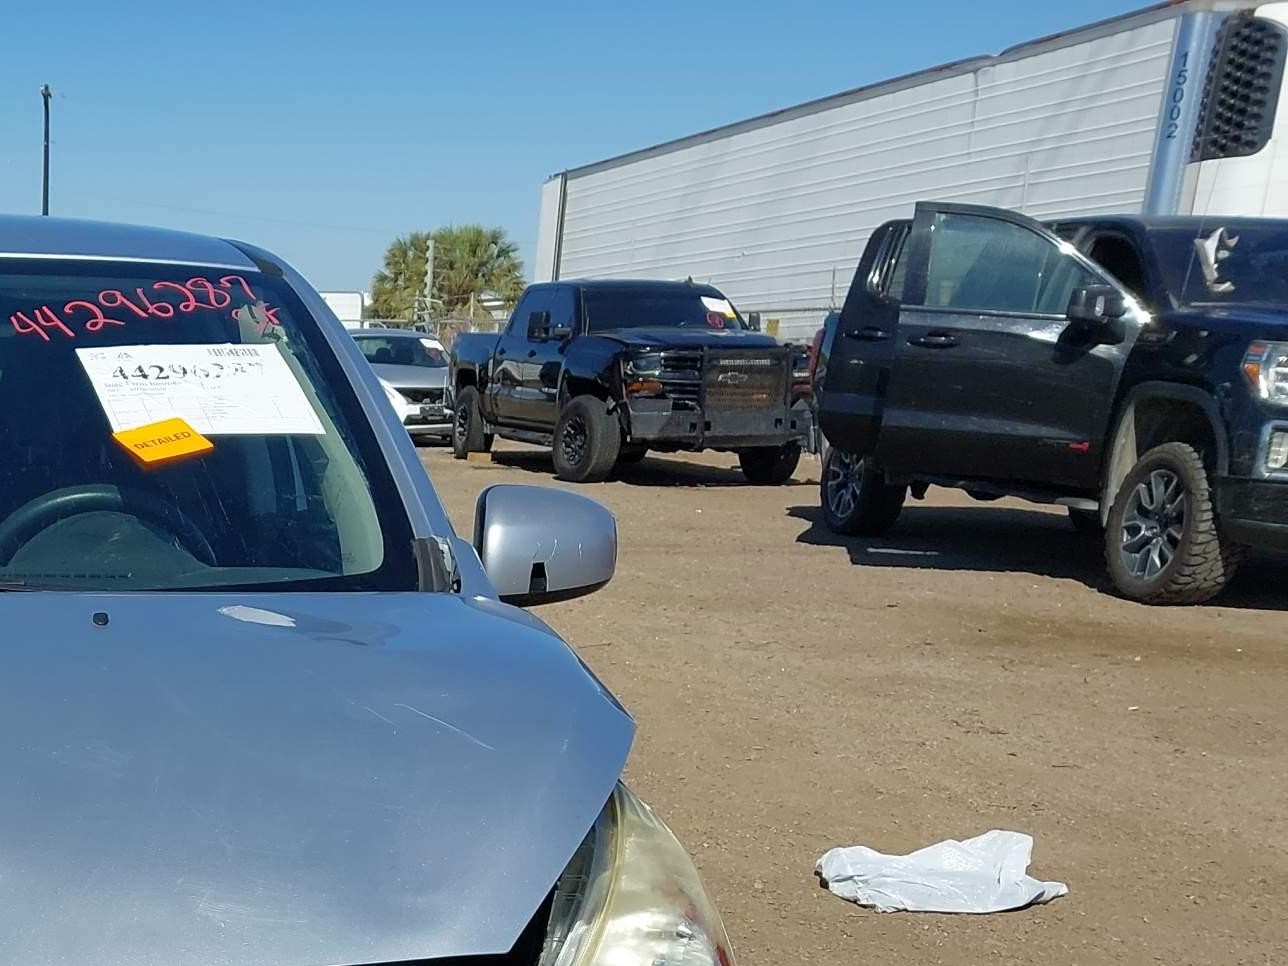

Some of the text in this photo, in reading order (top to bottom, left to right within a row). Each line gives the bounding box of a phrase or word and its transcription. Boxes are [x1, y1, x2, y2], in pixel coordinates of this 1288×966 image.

[1165, 51, 1189, 139] 15002
[10, 275, 256, 341] 44296287
[133, 431, 191, 450] DETAILED
